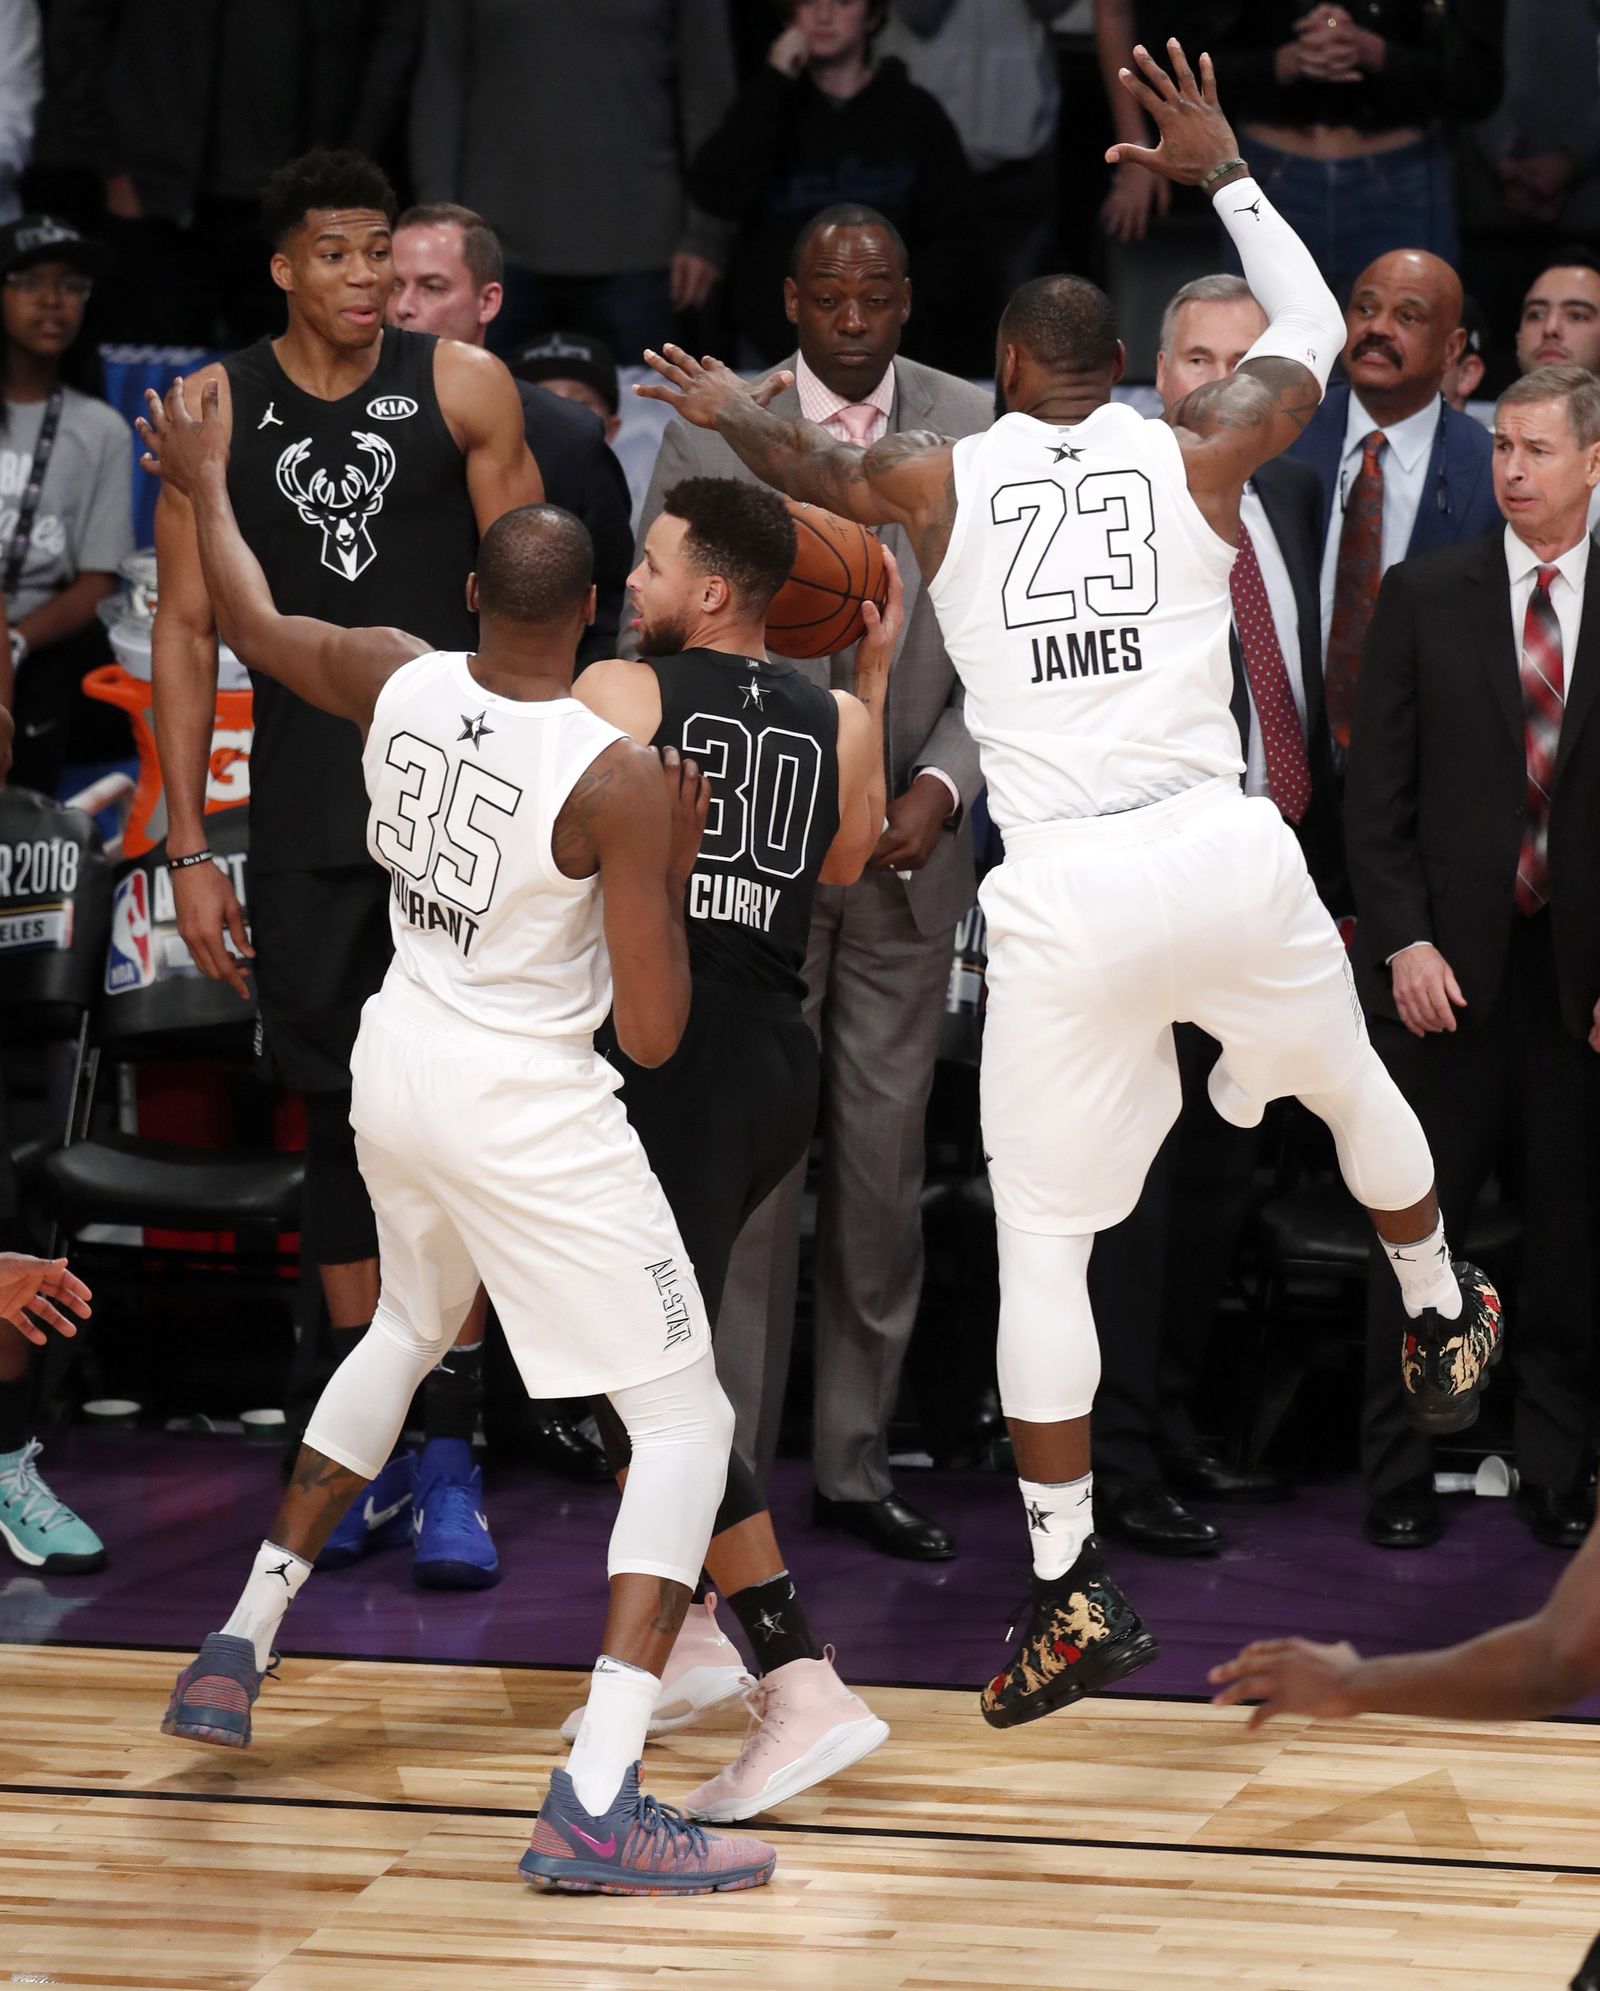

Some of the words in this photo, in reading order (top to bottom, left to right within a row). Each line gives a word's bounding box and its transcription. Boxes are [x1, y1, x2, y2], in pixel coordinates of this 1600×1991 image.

[375, 400, 411, 416] KIA
[990, 469, 1159, 630] 23
[1031, 627, 1143, 684] JAMES
[376, 730, 523, 916] 35
[682, 712, 822, 880] 30
[689, 873, 781, 933] CURRY
[644, 1258, 692, 1352] ALL-STAR
